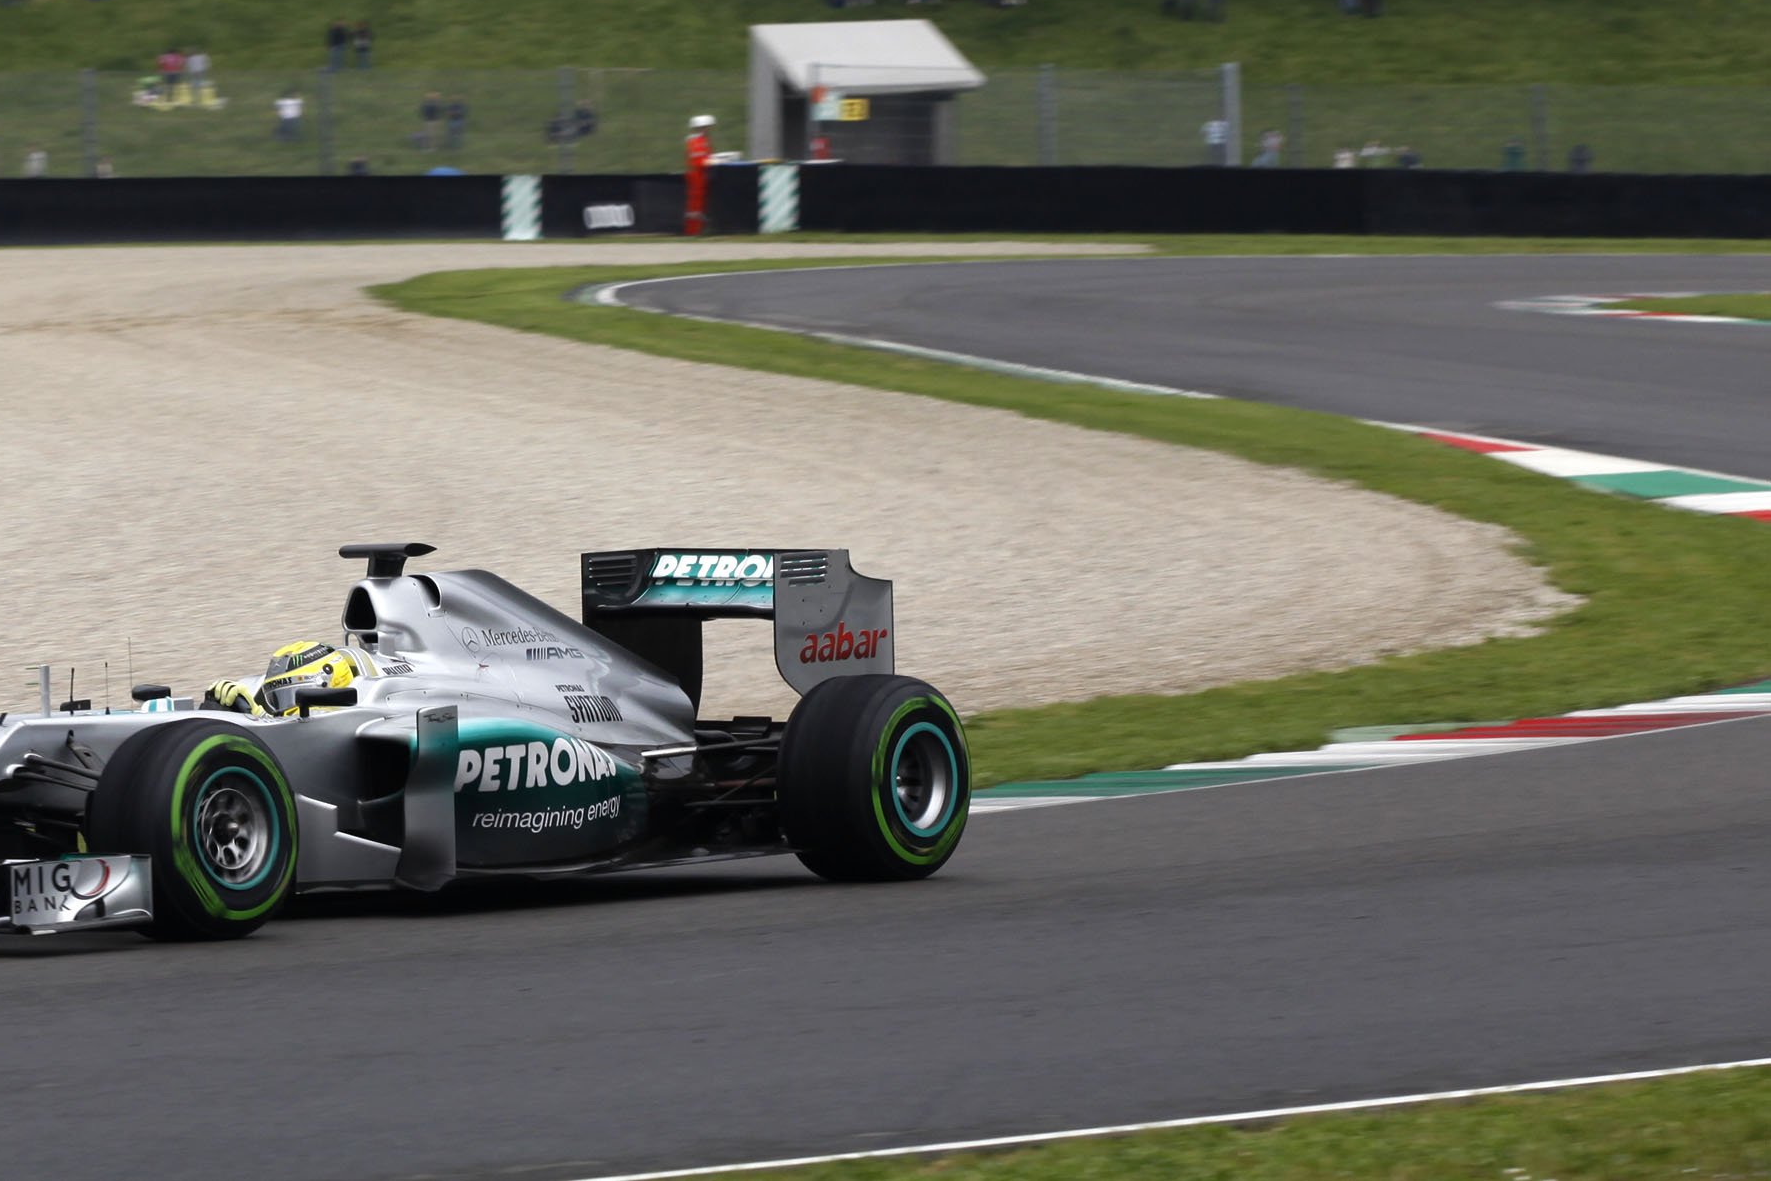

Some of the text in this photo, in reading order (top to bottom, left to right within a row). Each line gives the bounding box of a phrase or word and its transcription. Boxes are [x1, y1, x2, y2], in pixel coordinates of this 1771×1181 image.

[652, 555, 774, 586] PETRO
[547, 648, 585, 660] AMG
[799, 621, 888, 664] aabar
[453, 737, 617, 793] PETRONAS
[472, 795, 621, 833] reimagining energy
[14, 863, 71, 896] MIG
[14, 895, 71, 914] BANK
